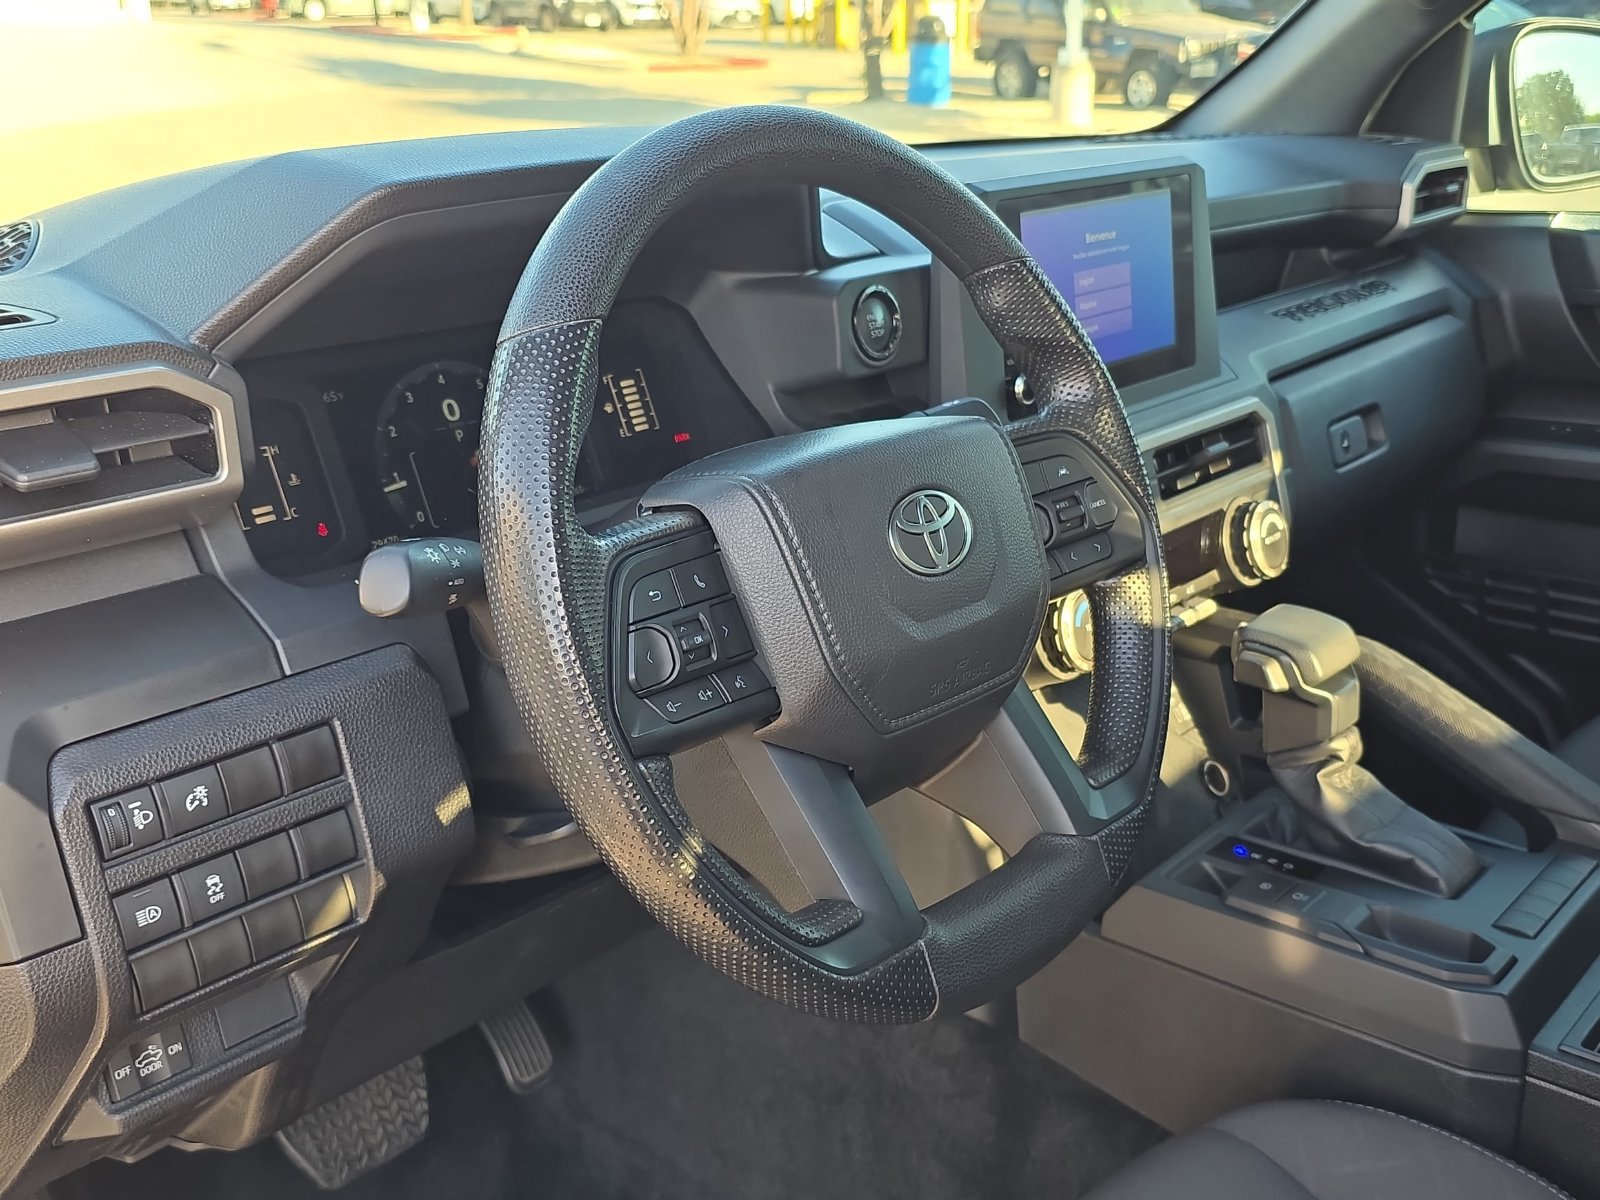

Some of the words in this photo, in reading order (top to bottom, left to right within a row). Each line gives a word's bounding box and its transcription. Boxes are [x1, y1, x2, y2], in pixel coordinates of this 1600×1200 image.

[438, 374, 446, 385] 4
[405, 391, 415, 404] 3
[442, 398, 461, 422] 0
[388, 425, 399, 438] 2
[693, 634, 705, 644] OK
[209, 891, 226, 904] OFF
[167, 1042, 183, 1056] ON
[114, 1065, 132, 1080] OFF
[139, 1060, 164, 1077] DOOR
